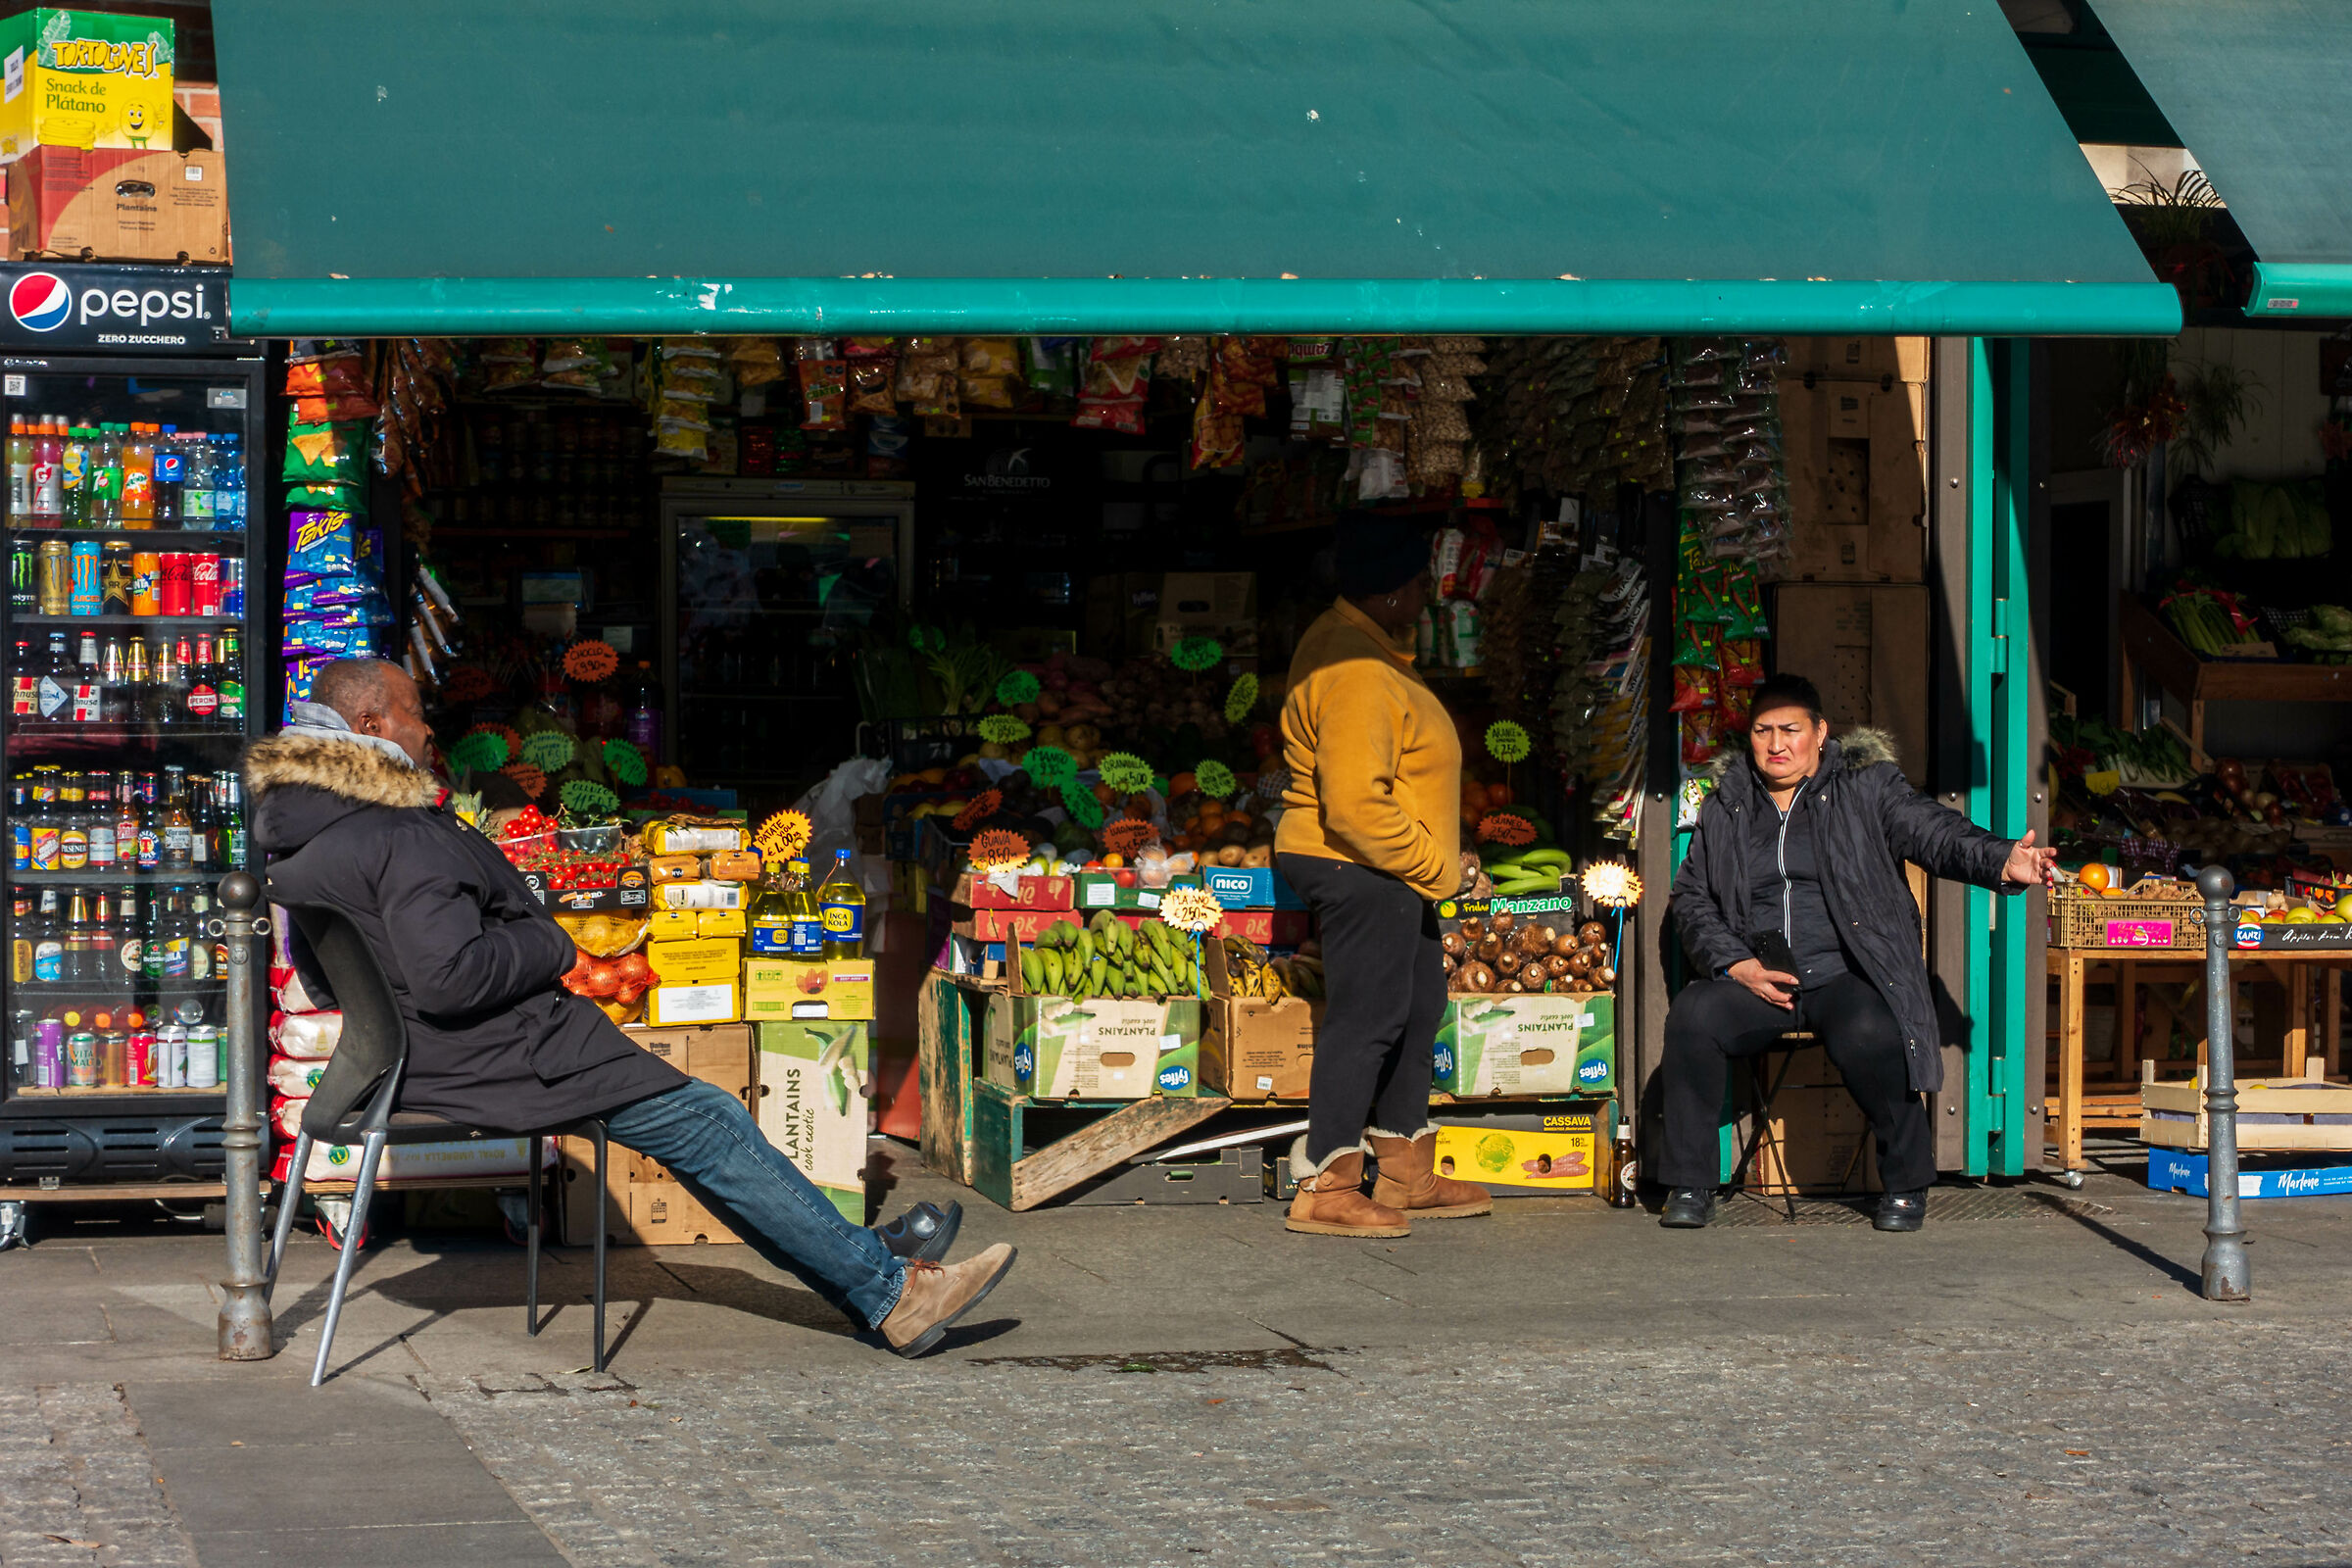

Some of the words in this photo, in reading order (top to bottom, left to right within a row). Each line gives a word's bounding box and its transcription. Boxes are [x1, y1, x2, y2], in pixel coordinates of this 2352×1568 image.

[46, 78, 87, 96] Snack
[91, 82, 107, 96] de
[46, 94, 106, 114] Plátano
[117, 203, 157, 213] Plantains
[80, 284, 204, 326] pepsi
[98, 333, 126, 344] ZERO
[128, 334, 185, 345] ZUCCHERO
[988, 475, 1052, 487] BENEDETTO
[757, 819, 785, 846] PATATE
[777, 821, 796, 837] VIOLA
[981, 834, 1010, 848] GUAVA
[1216, 878, 1248, 890] nico
[1491, 897, 1572, 915] Manzano
[828, 918, 849, 927] KOLA
[1098, 1026, 1156, 1036] PLANTAINS
[1517, 1023, 1573, 1033] PLANTAINS
[785, 1067, 801, 1159] LANTAINS
[803, 1107, 814, 1142] exotic
[1544, 1116, 1591, 1127] CASSAVA
[1570, 1137, 1581, 1148] 18
[804, 1144, 814, 1171] cook
[2278, 1172, 2319, 1197] Marlene
